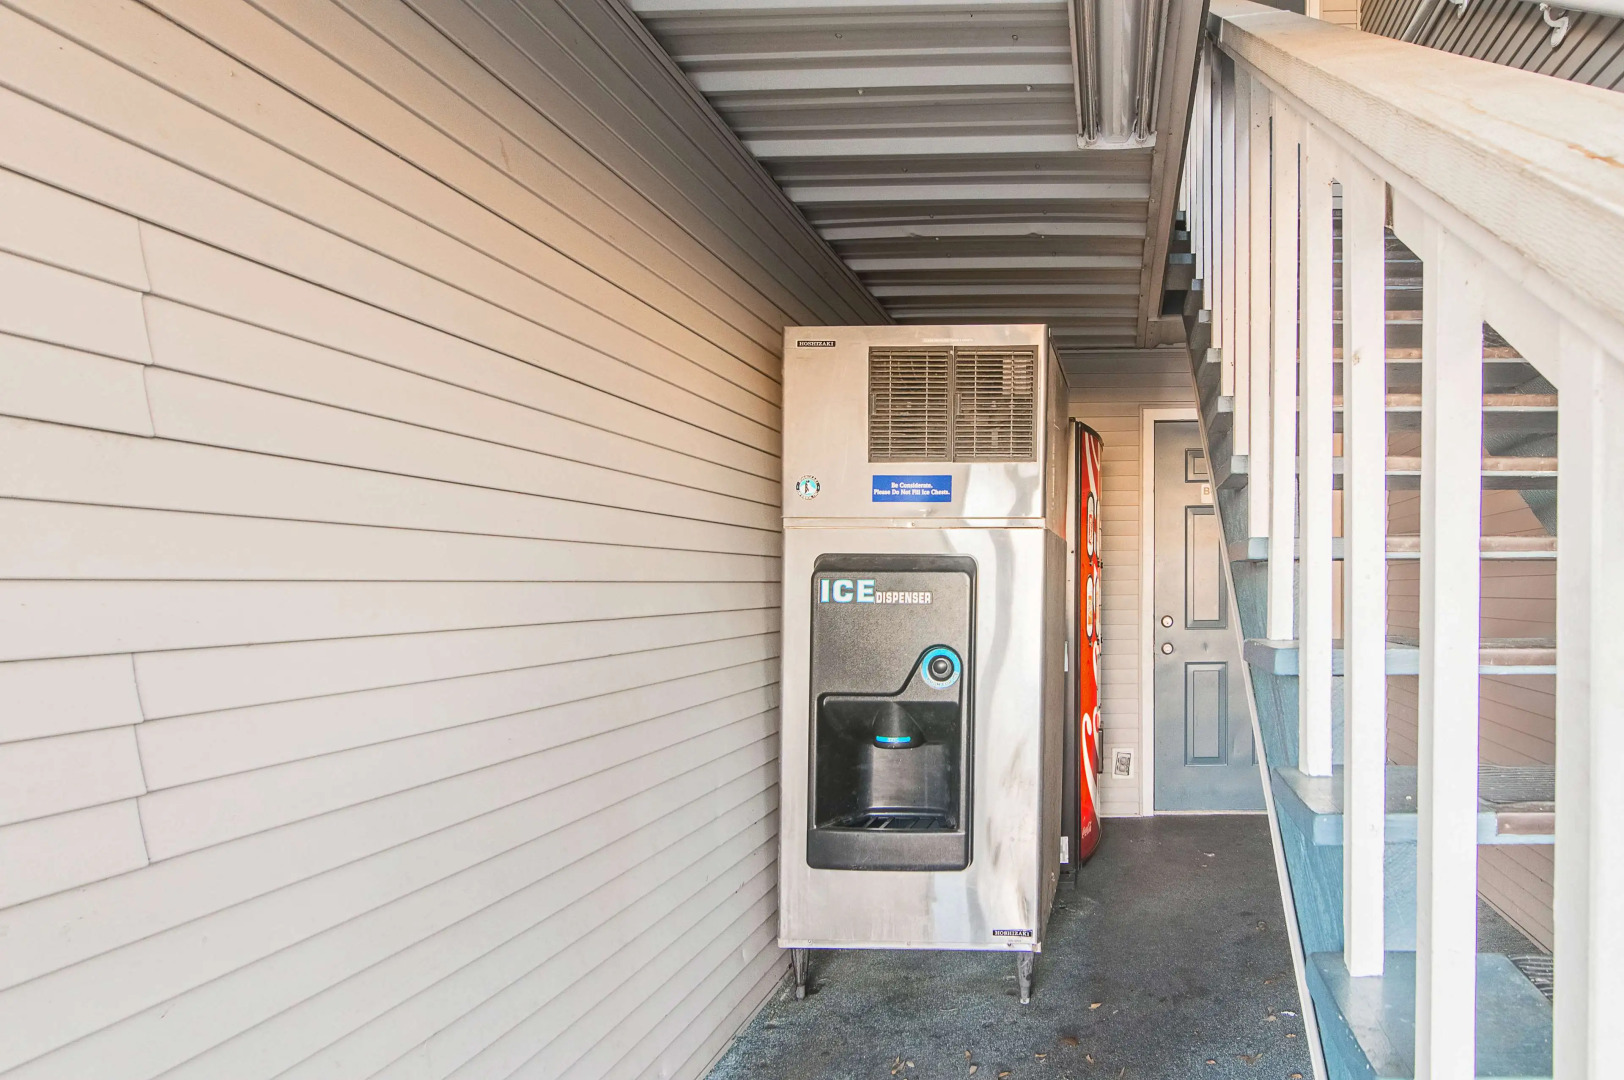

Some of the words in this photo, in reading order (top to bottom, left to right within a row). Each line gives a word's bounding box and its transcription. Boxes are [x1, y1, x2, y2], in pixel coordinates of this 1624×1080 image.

[1203, 487, 1210, 495] B
[820, 579, 875, 603] ICE
[875, 591, 932, 604] DISPENSER
